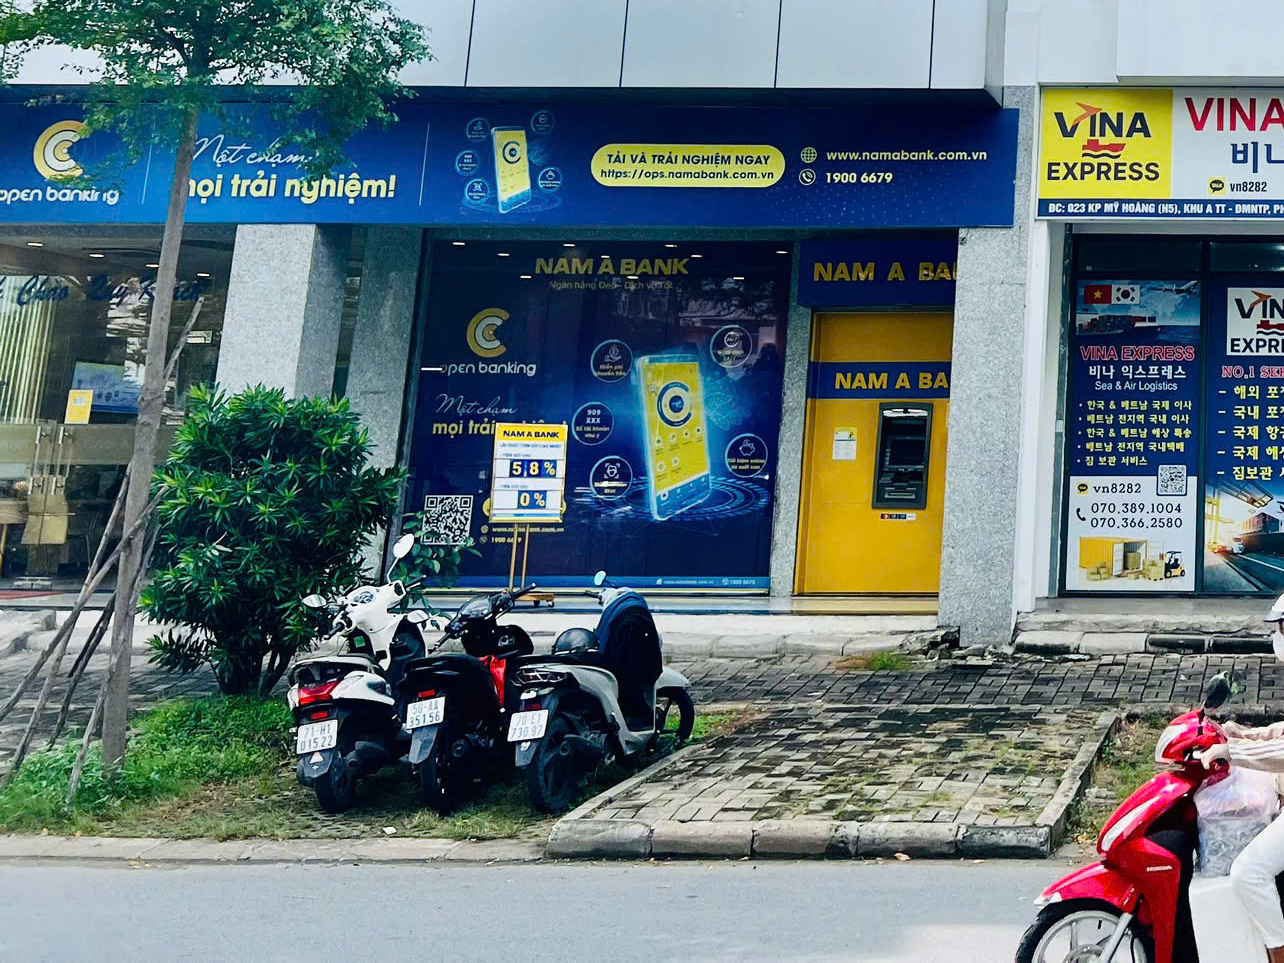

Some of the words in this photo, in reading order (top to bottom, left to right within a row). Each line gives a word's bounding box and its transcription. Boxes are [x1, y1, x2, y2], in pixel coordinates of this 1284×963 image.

[1053, 111, 1152, 138] VINA
[606, 150, 627, 165] TẢI
[628, 150, 648, 165] VÀ
[651, 150, 679, 165] TRẢI
[681, 151, 731, 168] NGHIỆM
[734, 153, 771, 165] NGAY
[825, 148, 988, 161] www.namabank.com.vn
[600, 167, 775, 183] https://ops.namabank.com.vn
[825, 171, 858, 184] 1900
[860, 172, 894, 184] 6679
[1046, 161, 1161, 182] EXPRESS
[231, 169, 278, 198] trải
[1229, 181, 1268, 193] vn8282
[1067, 203, 1086, 214] 023
[1088, 203, 1101, 214] KP
[1158, 203, 1182, 216] (H5),
[1183, 203, 1204, 215] KHU
[1205, 203, 1214, 215] A
[1215, 204, 1227, 215] TT
[535, 257, 594, 275] NAM
[597, 258, 615, 275] A
[619, 258, 690, 276] BANK
[813, 262, 875, 282] NAM
[887, 262, 905, 282] A
[918, 261, 958, 282] BA
[1080, 345, 1119, 361] VINA
[1121, 345, 1196, 362] EXPRESS
[478, 361, 537, 377] banking
[1088, 364, 1115, 380] 비나
[1121, 364, 1187, 380] 익스프레스
[1221, 365, 1255, 379] NO.1
[834, 372, 888, 390] NAM
[894, 372, 911, 390] A
[918, 372, 949, 389] BA
[1095, 381, 1113, 391] Sea
[1115, 381, 1122, 391] &
[1123, 381, 1137, 391] Air
[1138, 381, 1178, 393] Logistics
[1233, 385, 1260, 400] 해외
[1233, 405, 1260, 420] 국내
[432, 420, 464, 439] mọi
[468, 417, 496, 435] trải
[503, 430, 525, 438] NAM
[534, 431, 560, 439] BANK
[1232, 425, 1259, 440] 국제
[1232, 445, 1259, 461] 국제
[1232, 465, 1273, 481] 짐보관
[1092, 482, 1142, 495] vn8282
[1090, 502, 1182, 515] 070.389.1004
[1090, 517, 1183, 529] 070.366.2580
